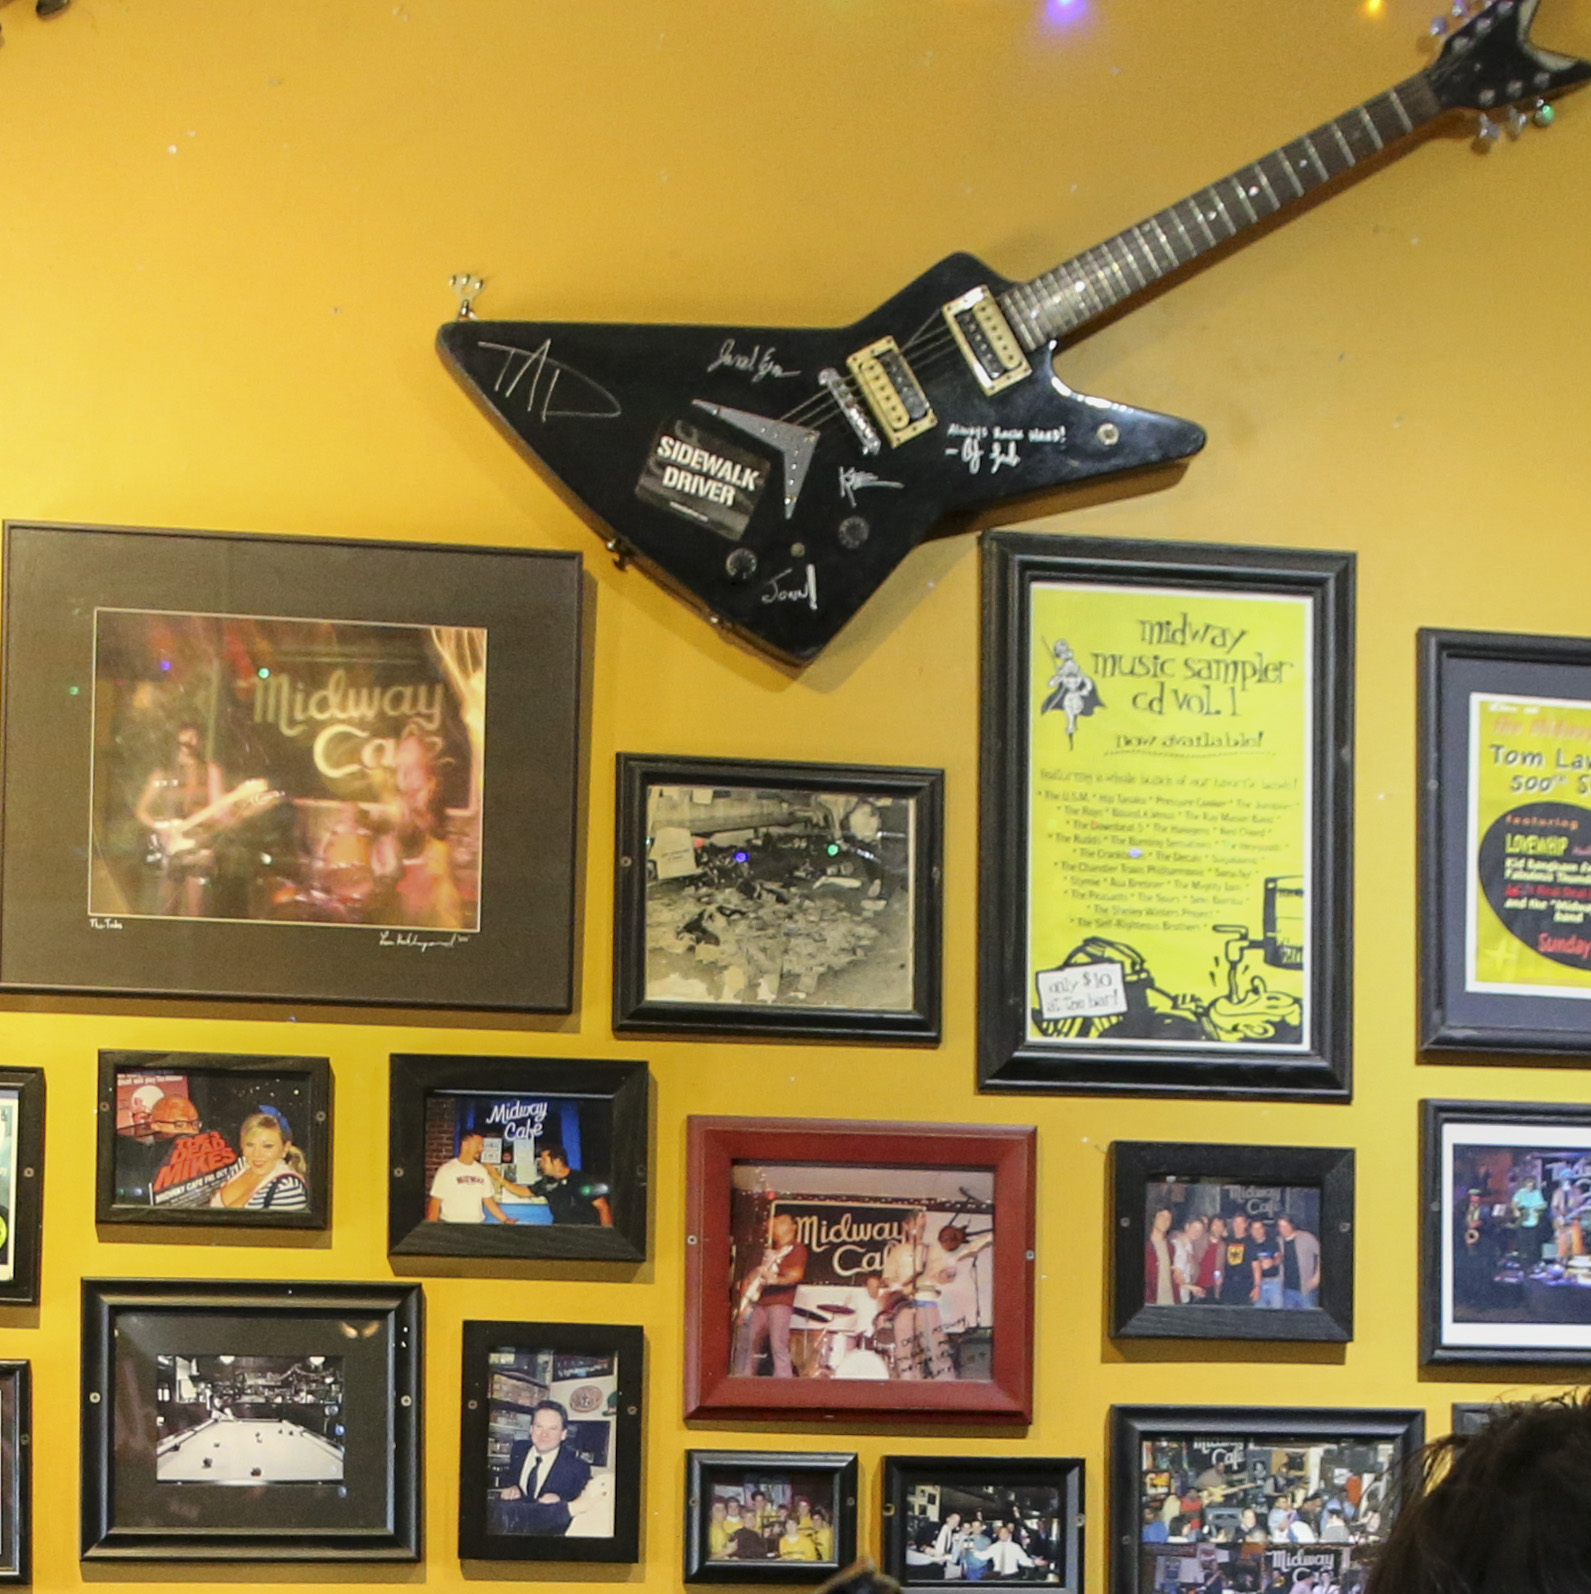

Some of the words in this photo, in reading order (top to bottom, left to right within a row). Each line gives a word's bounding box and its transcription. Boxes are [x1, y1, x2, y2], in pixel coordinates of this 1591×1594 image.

[657, 435, 760, 492] SIDEWALK
[662, 465, 736, 508] DRIVER
[1137, 612, 1248, 654] midway
[1090, 652, 1175, 679] music
[1184, 652, 1294, 692] sampler
[253, 668, 445, 737] Midway
[1131, 681, 1165, 716] cd
[1171, 684, 1222, 716] vol.
[1115, 735, 1157, 749] now
[1161, 731, 1264, 749] available!
[1490, 744, 1544, 768] Tom
[1505, 814, 1580, 831] featuring
[1504, 897, 1527, 910] and
[1528, 897, 1548, 911] the
[1048, 977, 1077, 994] only
[1082, 971, 1112, 989] $10
[1087, 989, 1119, 1009] bar!
[485, 1099, 548, 1125] Midway
[503, 1118, 544, 1141] Cafe
[153, 1147, 237, 1192] MIKES
[1225, 1184, 1282, 1203] Midway
[1245, 1196, 1283, 1217] Cafe
[1266, 1549, 1335, 1573] Midway
